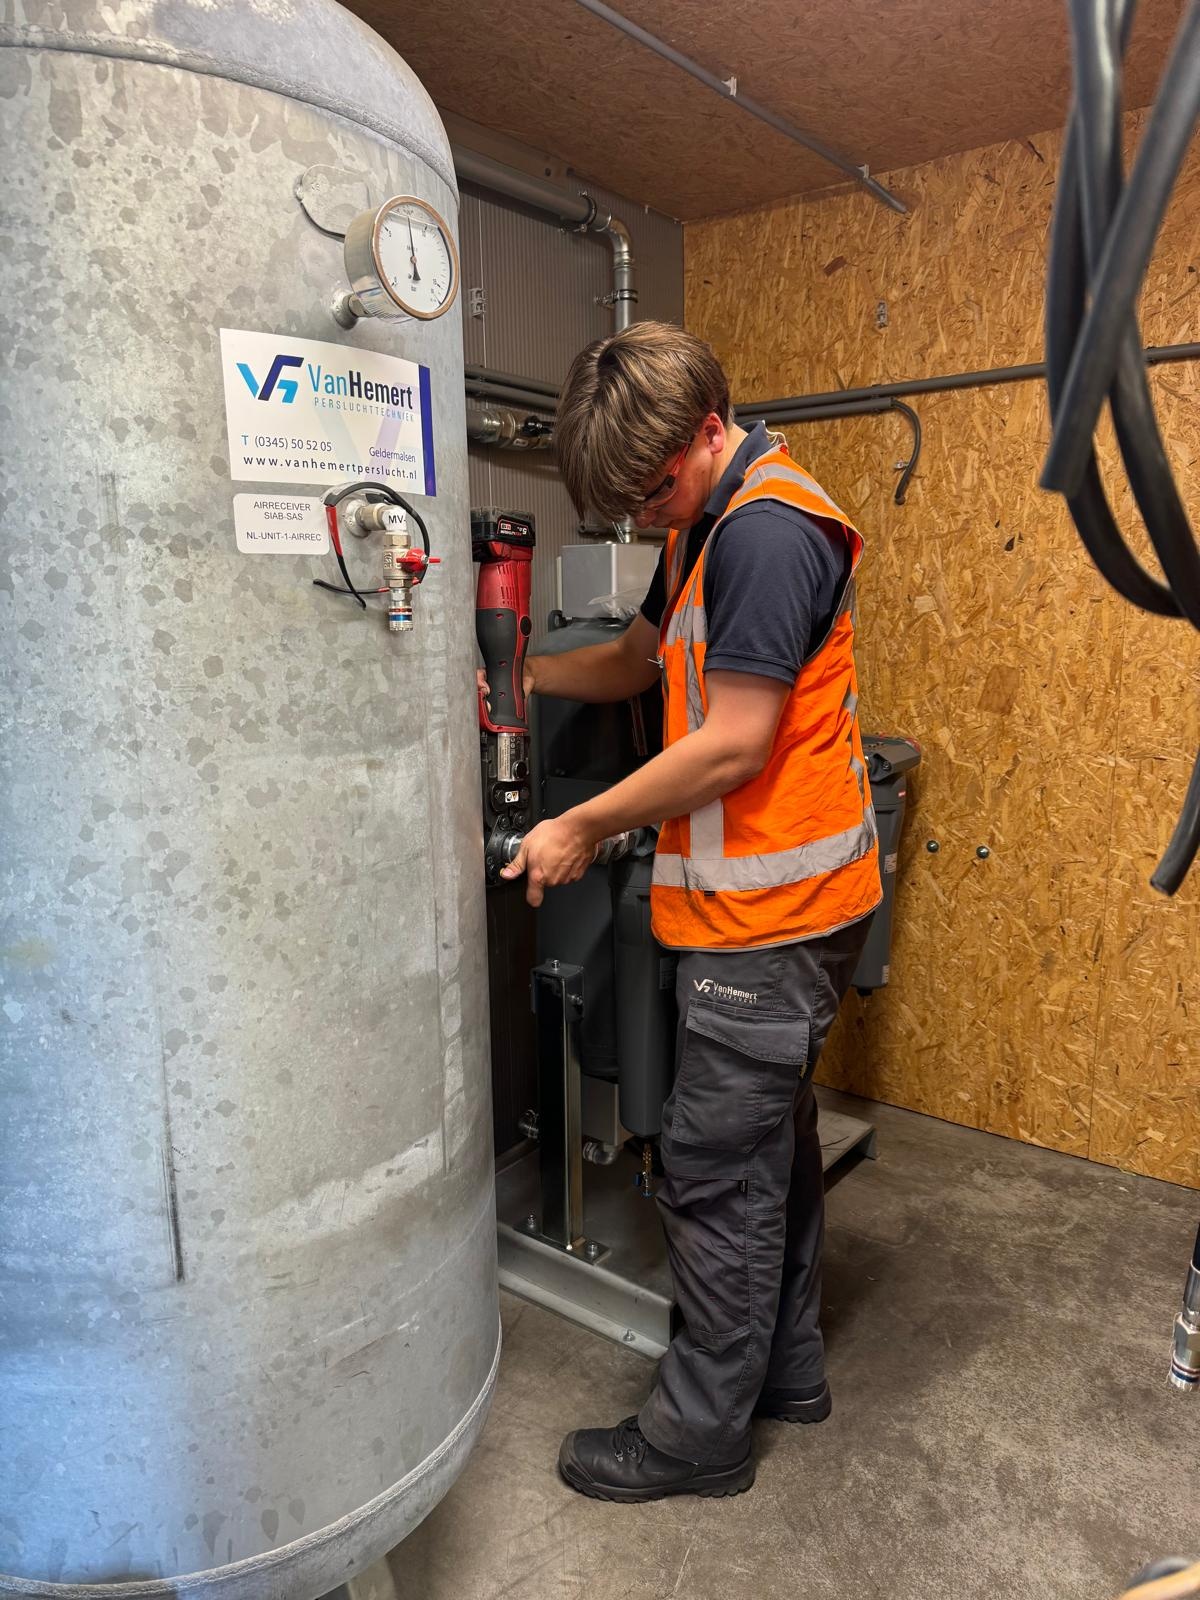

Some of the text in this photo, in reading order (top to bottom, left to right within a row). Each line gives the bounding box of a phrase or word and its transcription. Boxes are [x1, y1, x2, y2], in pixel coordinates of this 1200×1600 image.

[307, 363, 413, 410] VanHemert
[314, 396, 414, 422] PERSLUCHTTECHNIEK
[241, 435, 332, 452] T (0345) 50 52 05
[369, 446, 416, 463] Geldermalsen
[243, 456, 417, 480] www.vanhemertperslucht.nl
[253, 501, 311, 512] AIRRECEIVER
[264, 511, 304, 521] SIAB-SAS
[246, 531, 322, 542] NL-UNIT-1-AIRREC
[713, 982, 758, 1000] VanHemert
